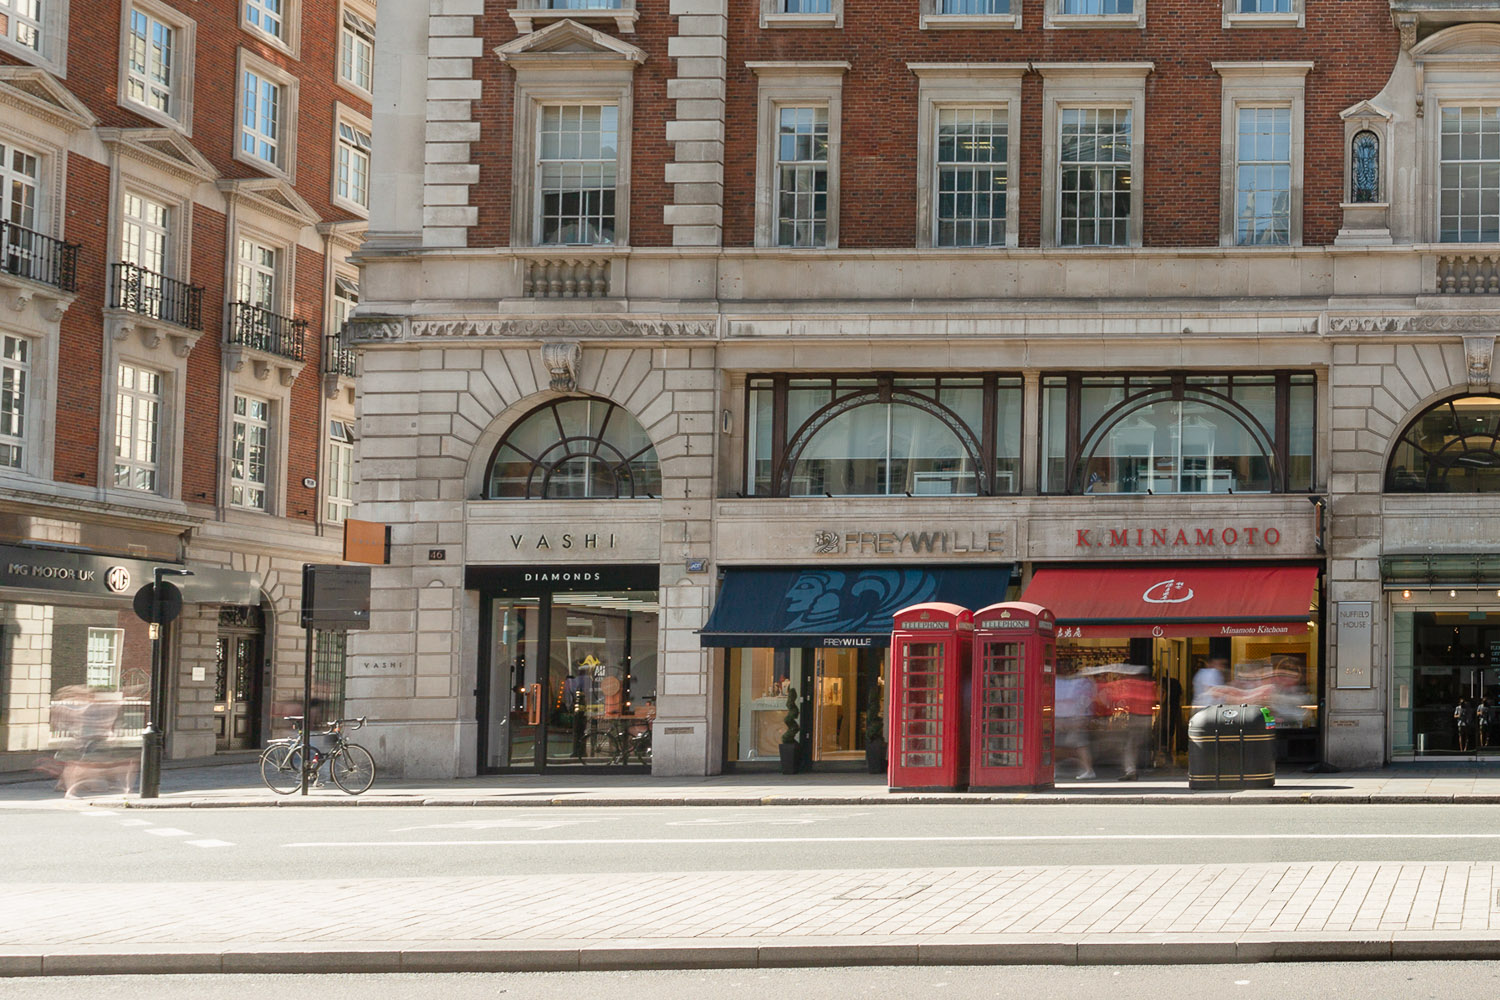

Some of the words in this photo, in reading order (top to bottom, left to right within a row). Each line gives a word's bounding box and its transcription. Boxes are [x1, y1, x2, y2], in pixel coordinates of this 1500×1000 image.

[510, 534, 616, 549] VASHI
[844, 531, 1004, 554] FREYWILLE
[430, 550, 443, 559] 46
[8, 563, 28, 576] MG
[32, 565, 75, 579] MOTOR
[79, 570, 95, 581] UK
[525, 572, 600, 581] DIAMONDS
[110, 568, 128, 589] MG
[1220, 626, 1256, 634] Minamoto
[824, 638, 871, 646] FREYWILLE
